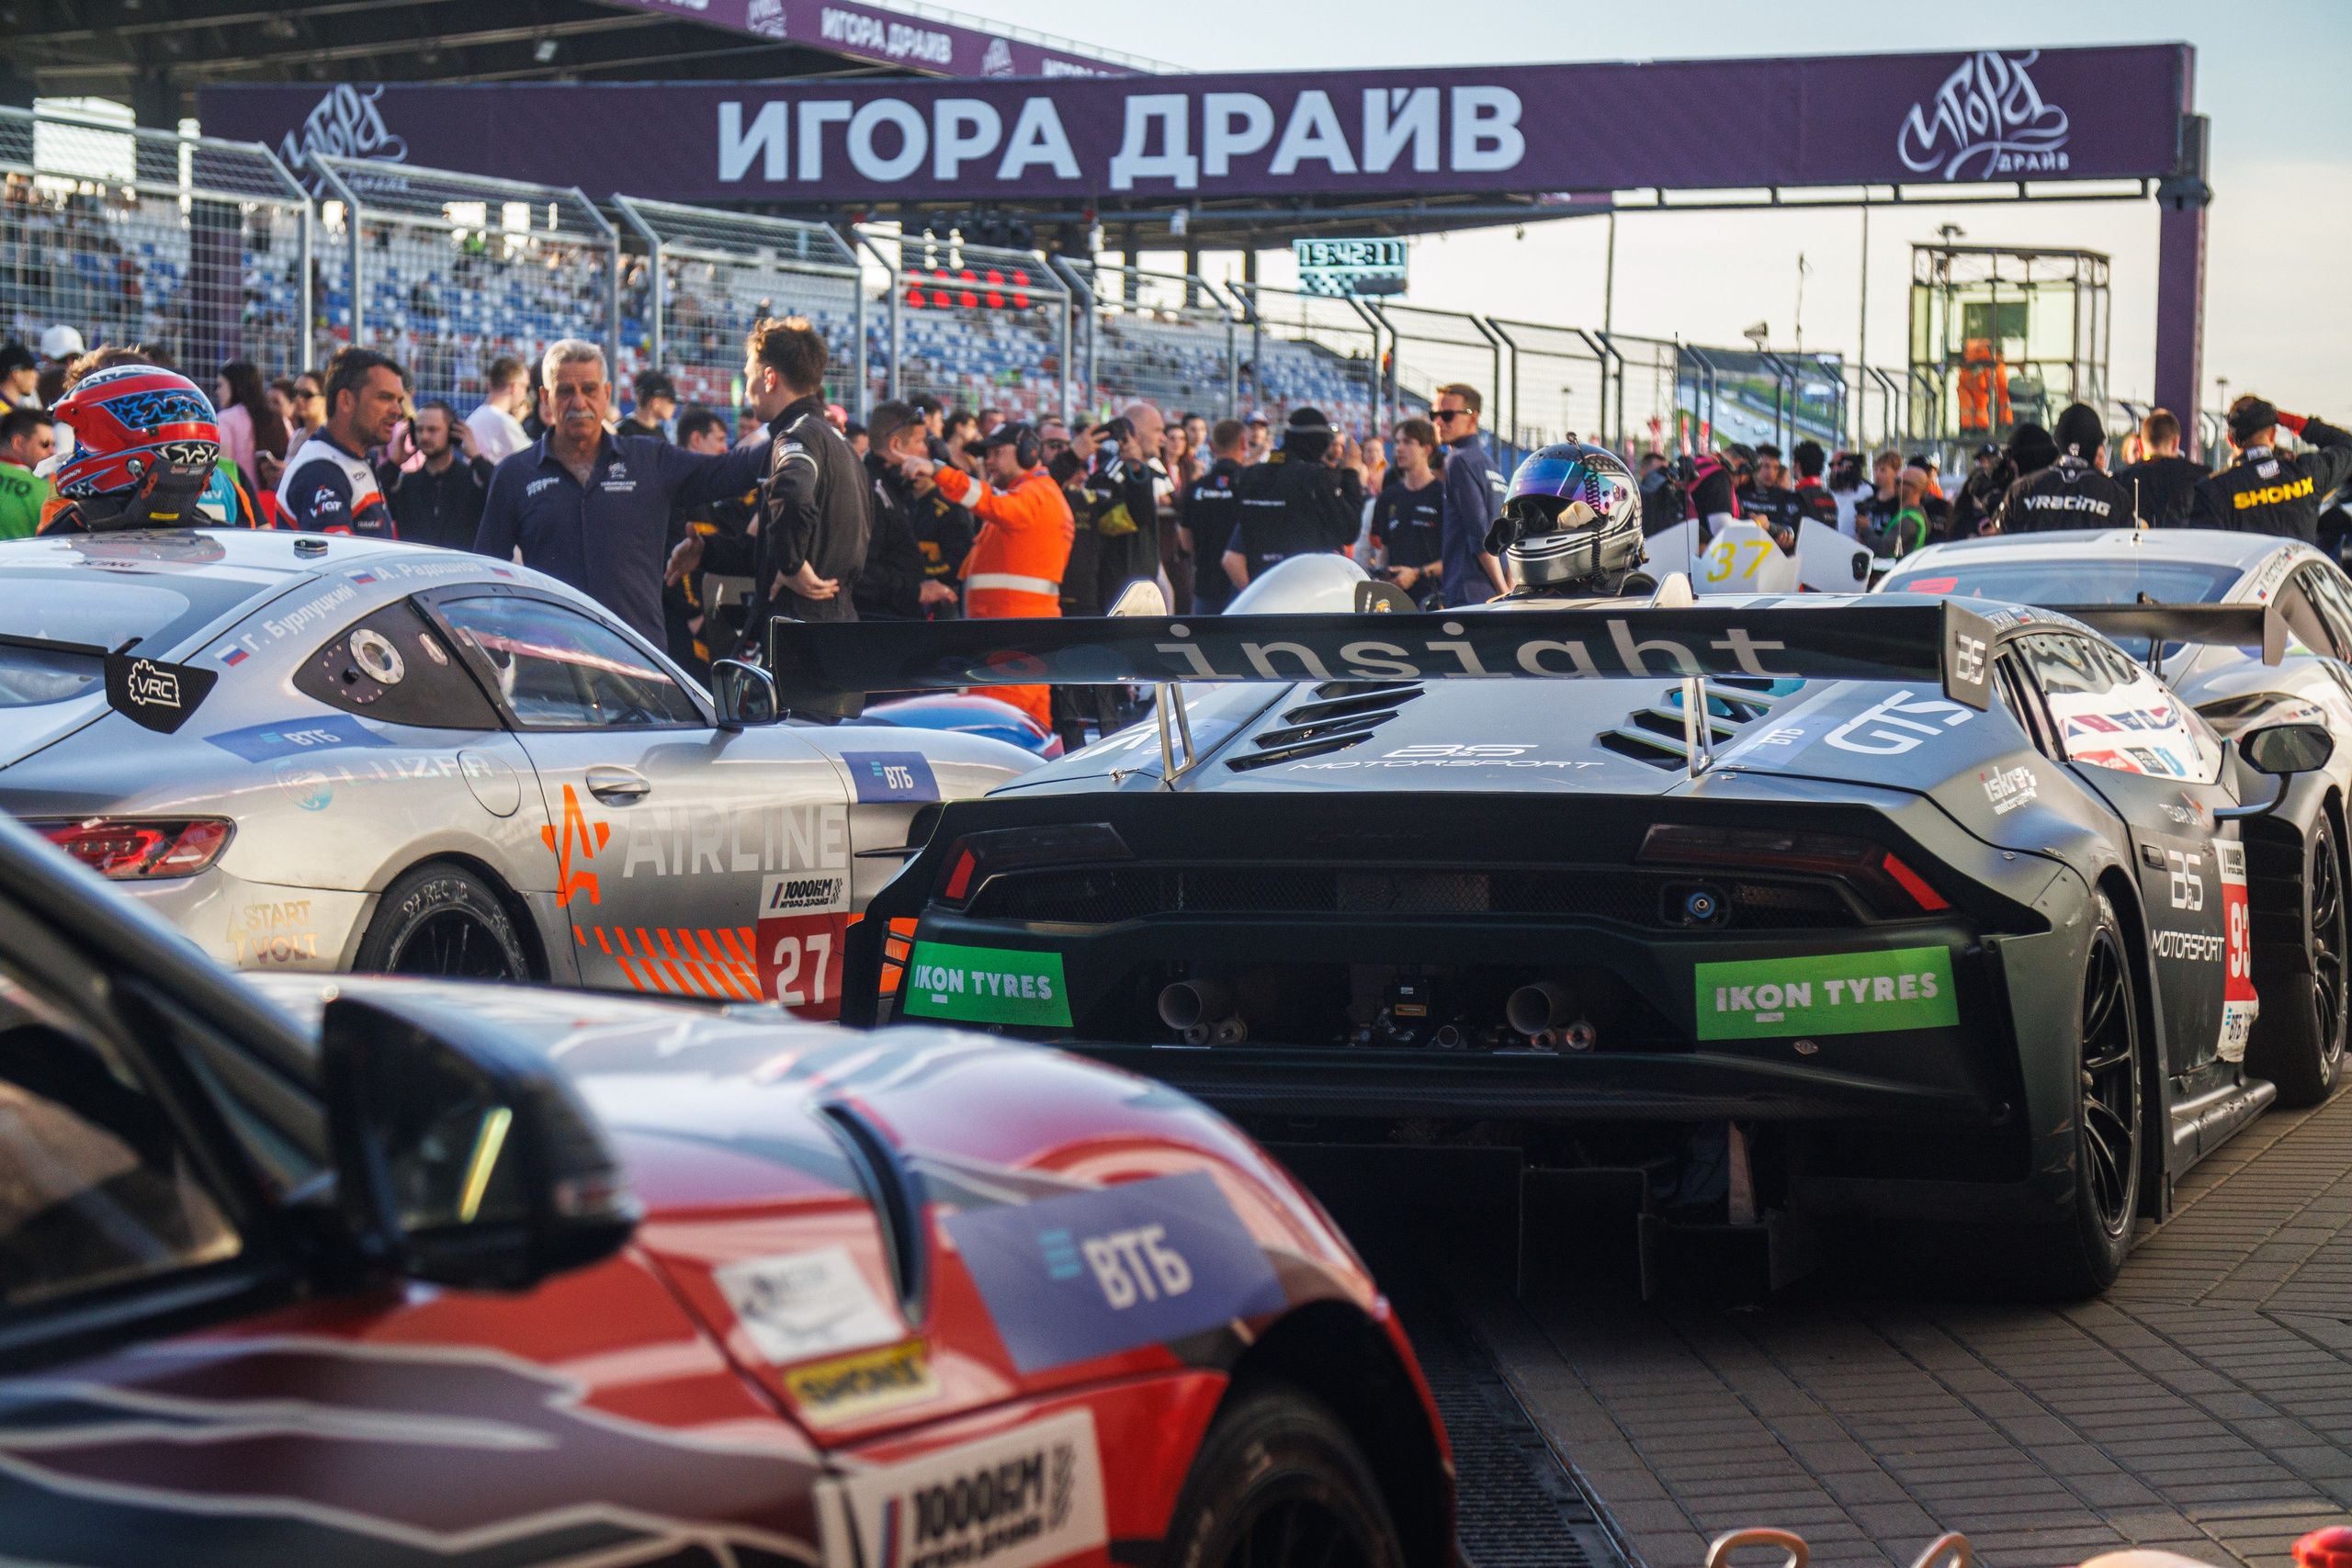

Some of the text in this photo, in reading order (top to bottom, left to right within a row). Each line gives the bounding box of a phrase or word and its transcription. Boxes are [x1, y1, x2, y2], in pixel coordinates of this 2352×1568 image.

[820, 7, 886, 51] ИГОРА
[718, 85, 1526, 189] ИГОРА ДРАЙВ
[1996, 151, 2070, 173] ДРАЙВ
[1299, 243, 1402, 266] 19:42:11
[2233, 476, 2313, 510] SHONX
[373, 565, 399, 581] А.
[1707, 540, 1773, 582] 37
[241, 582, 357, 652] Г. Бурлуцкий
[1154, 620, 1804, 680] insight
[137, 675, 174, 699] VRC
[283, 728, 342, 746] ВТБ
[1757, 728, 1806, 746] ВТБ
[1825, 690, 1974, 754] GTS
[1288, 760, 1605, 772] MOTORSPORT
[1382, 744, 1540, 758] B&S
[884, 765, 914, 790] ВТБ
[623, 804, 847, 877] AIRLINE
[424, 880, 449, 907] REC
[784, 878, 832, 899] 1000КМ
[244, 900, 311, 930] START
[251, 932, 318, 964] VOLT
[2151, 929, 2225, 963] MOTORSPORT
[2230, 901, 2251, 978] 93
[773, 932, 831, 1008] 27
[915, 964, 1053, 999] IKON TYRES
[1716, 972, 1939, 1011] IKON TYRES
[1082, 1225, 1193, 1311] ВТБ
